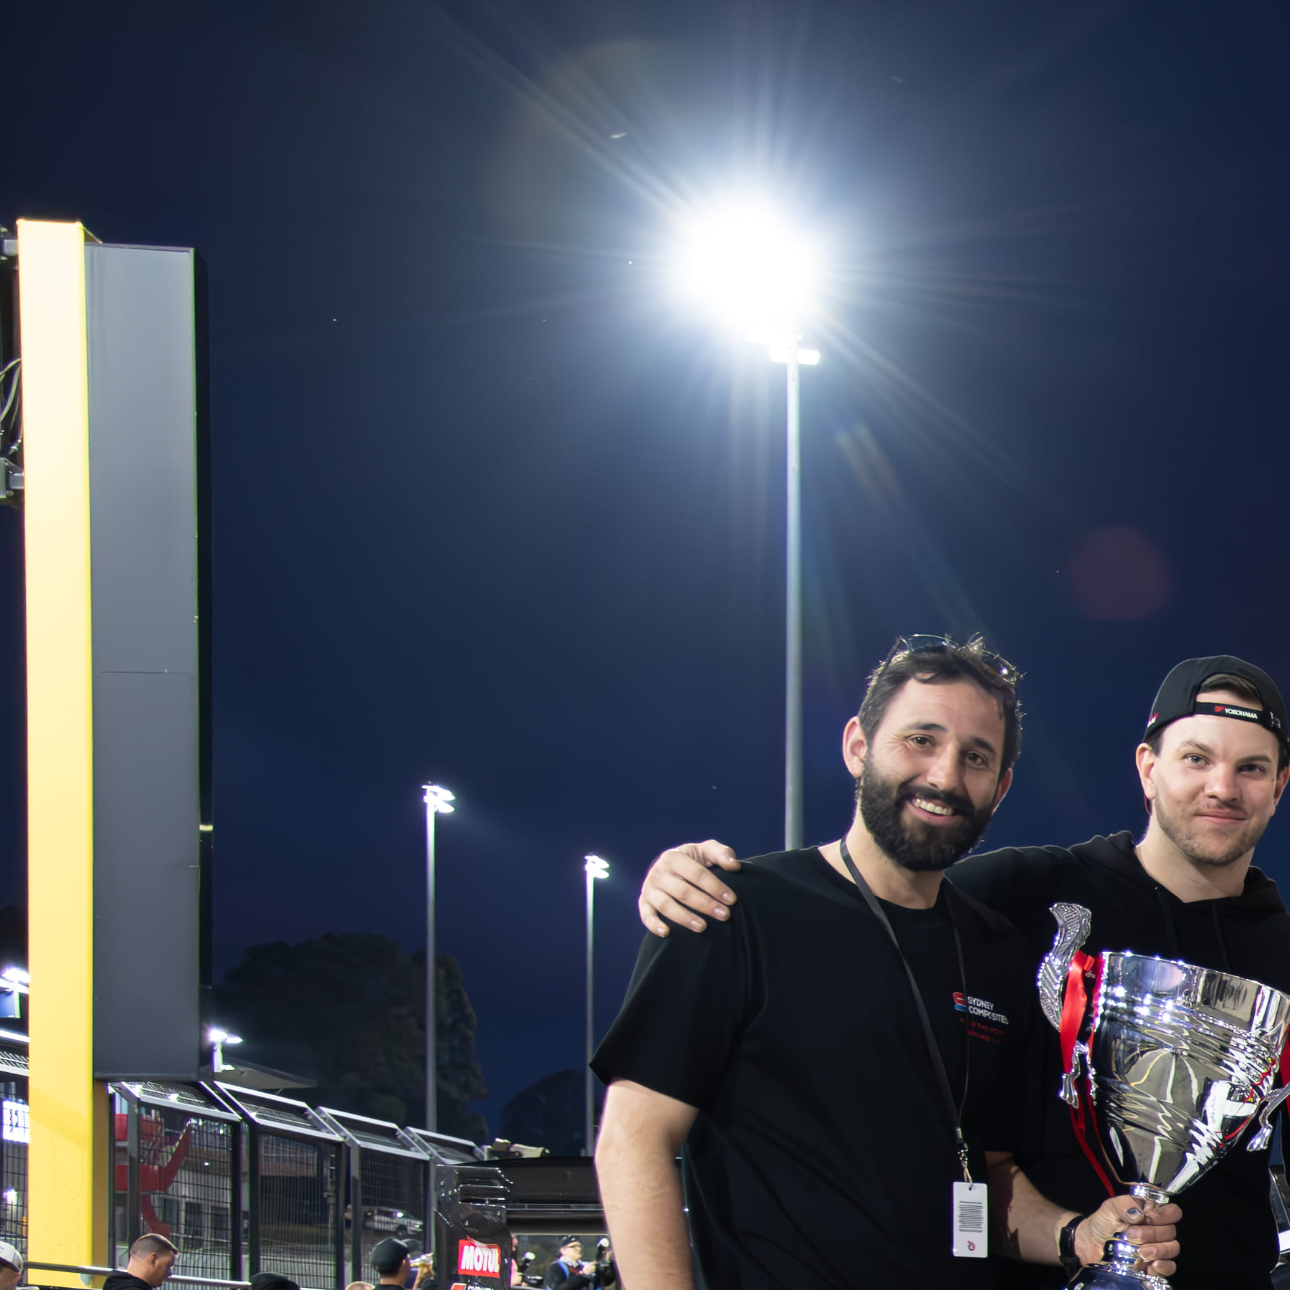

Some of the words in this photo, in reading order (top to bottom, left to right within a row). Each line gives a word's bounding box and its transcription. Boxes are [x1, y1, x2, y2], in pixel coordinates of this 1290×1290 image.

[1225, 707, 1259, 720] YOKOHAMA
[967, 996, 994, 1011] SYDNEY
[968, 1005, 1009, 1025] COMPOSITES
[461, 1245, 500, 1273] MOTUL
